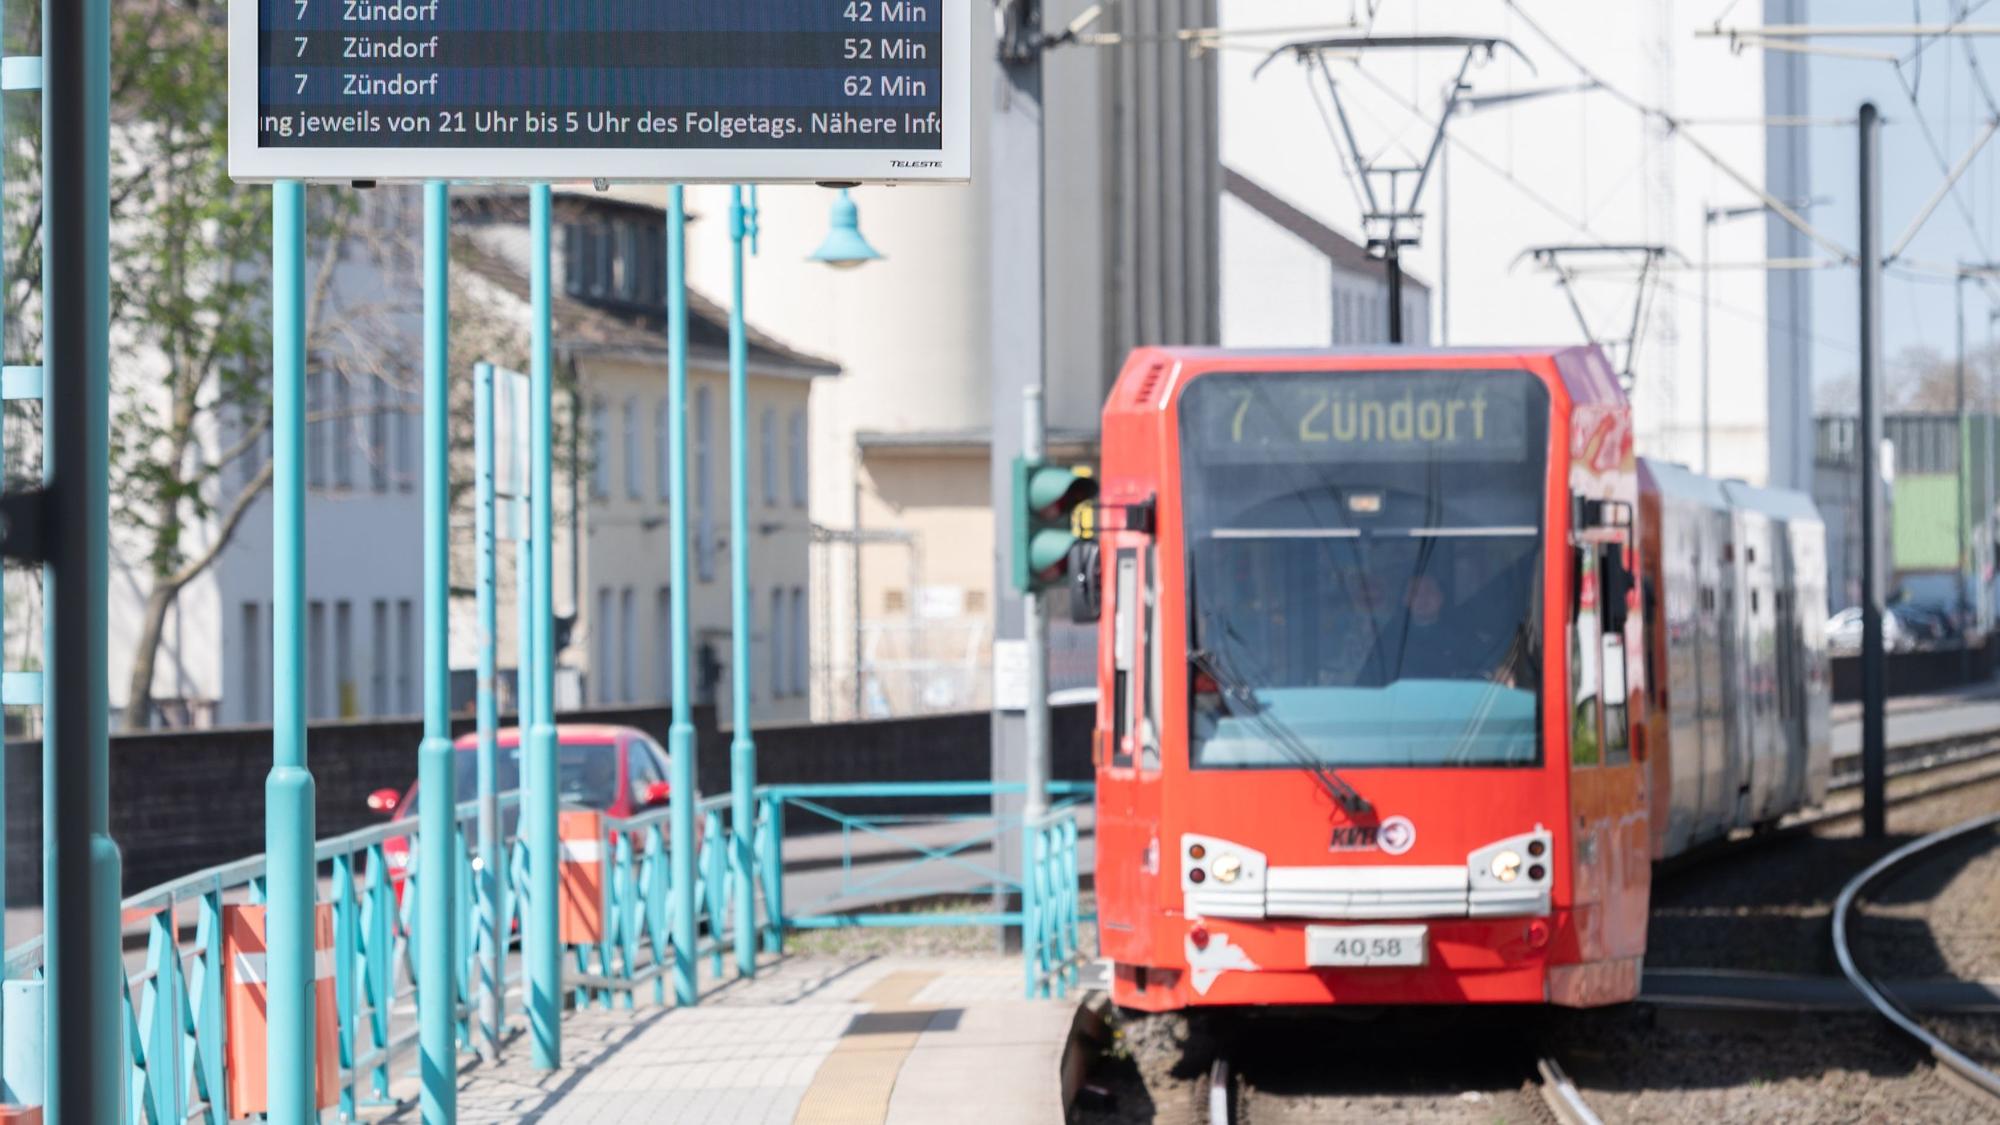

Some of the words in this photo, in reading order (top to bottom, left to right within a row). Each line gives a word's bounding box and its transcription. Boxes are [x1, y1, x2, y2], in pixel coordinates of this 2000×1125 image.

[294, 0, 308, 20] 7
[343, 0, 439, 21] Zündorf
[843, 1, 873, 22] 42
[880, 1, 926, 22] Min
[294, 36, 308, 58] 7
[343, 35, 439, 58] Zündorf
[843, 38, 873, 59] 52
[880, 38, 926, 59] Min
[294, 73, 308, 95] 7
[343, 72, 439, 95] Zündorf
[843, 75, 873, 96] 62
[880, 75, 926, 96] Min
[260, 116, 293, 137] ng
[297, 110, 381, 137] jeweils
[387, 116, 430, 132] von
[439, 111, 467, 132] 21
[475, 110, 519, 132] Uhr
[525, 110, 558, 132] bis
[565, 111, 579, 132] 5
[587, 111, 631, 133] Uhr
[637, 110, 678, 133] des
[685, 111, 803, 138] Folgetags.
[811, 111, 897, 134] Nähere
[890, 160, 942, 168] TELESTE
[1229, 389, 1253, 443] 7
[1299, 386, 1489, 442] Zündorf
